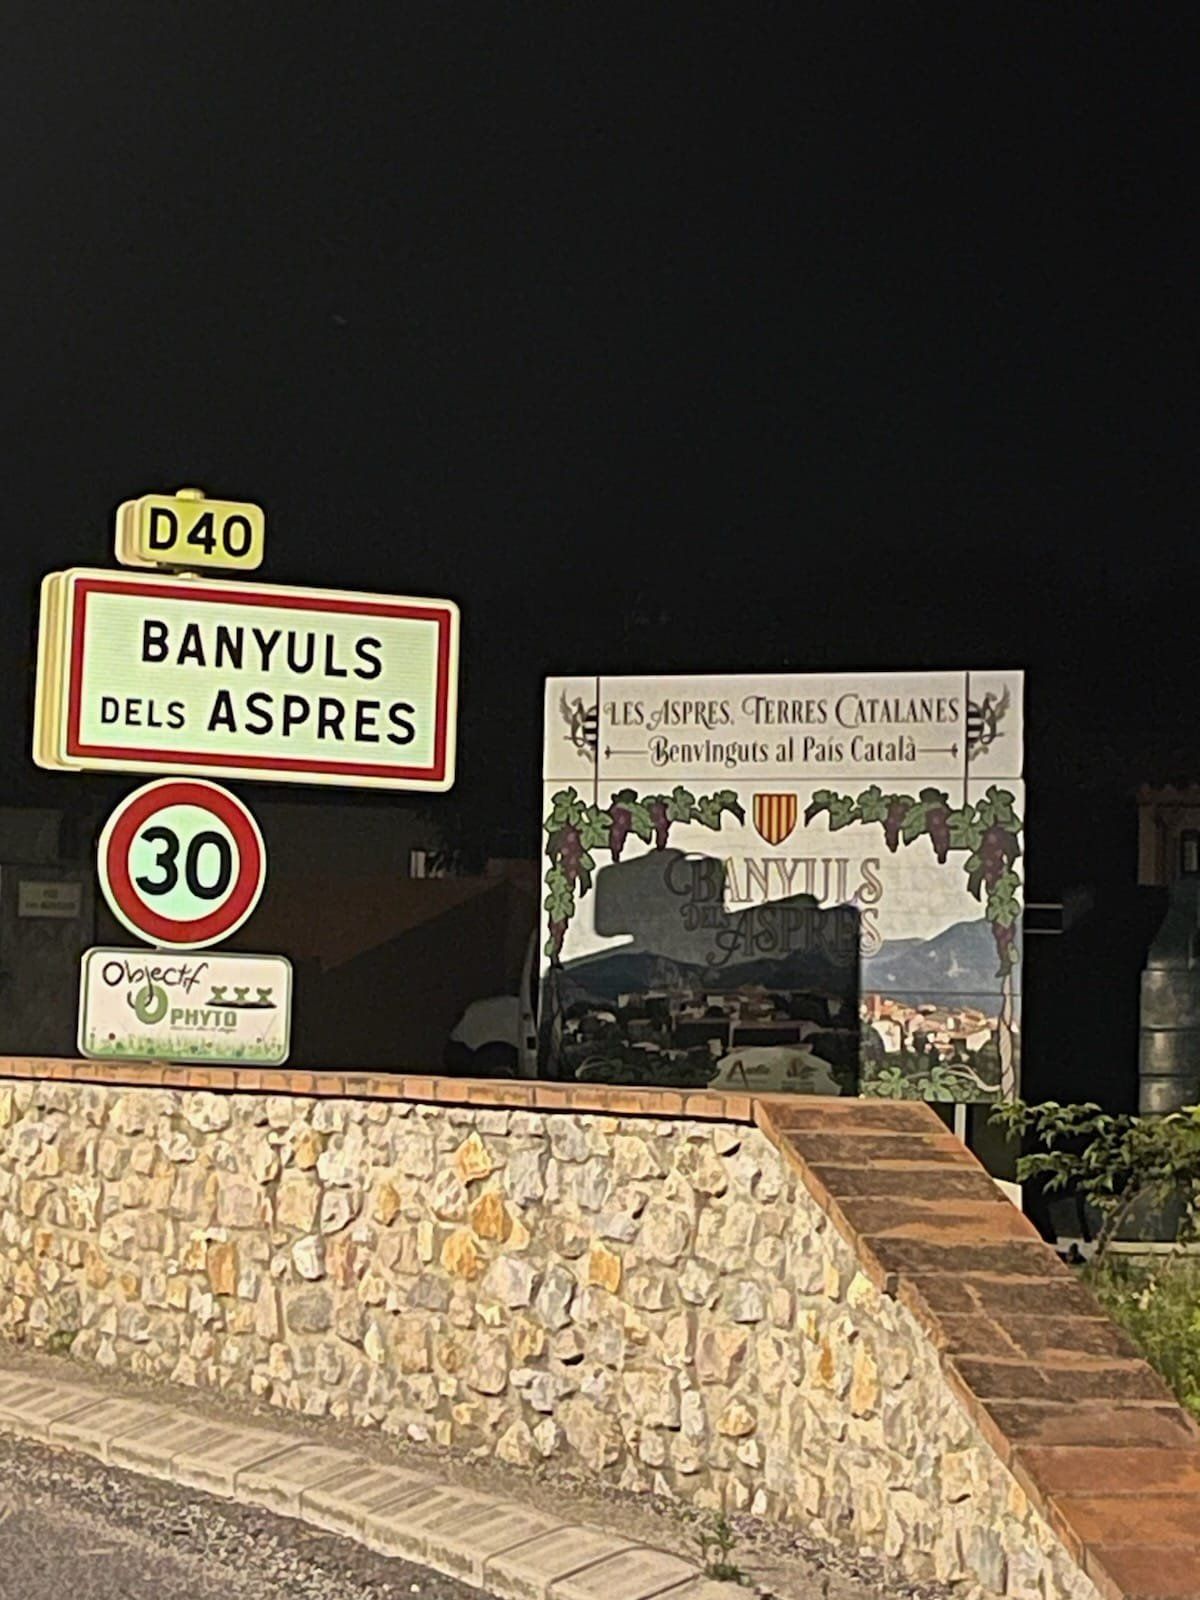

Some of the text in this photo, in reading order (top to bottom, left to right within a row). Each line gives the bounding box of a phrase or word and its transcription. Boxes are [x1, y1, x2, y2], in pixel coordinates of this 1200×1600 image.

[141, 619, 383, 680] BANYULS
[101, 689, 417, 745] DELS ASPRES
[603, 700, 645, 726] LES
[742, 695, 828, 725] TERRES
[835, 693, 960, 729] CATALANES
[648, 735, 917, 769] Benvinguts al País Català
[135, 826, 233, 900] 30
[663, 852, 884, 904] BANYULS
[705, 906, 884, 967] ASPRES
[102, 959, 209, 1010] Objectif
[170, 1008, 237, 1027] PHYTO
